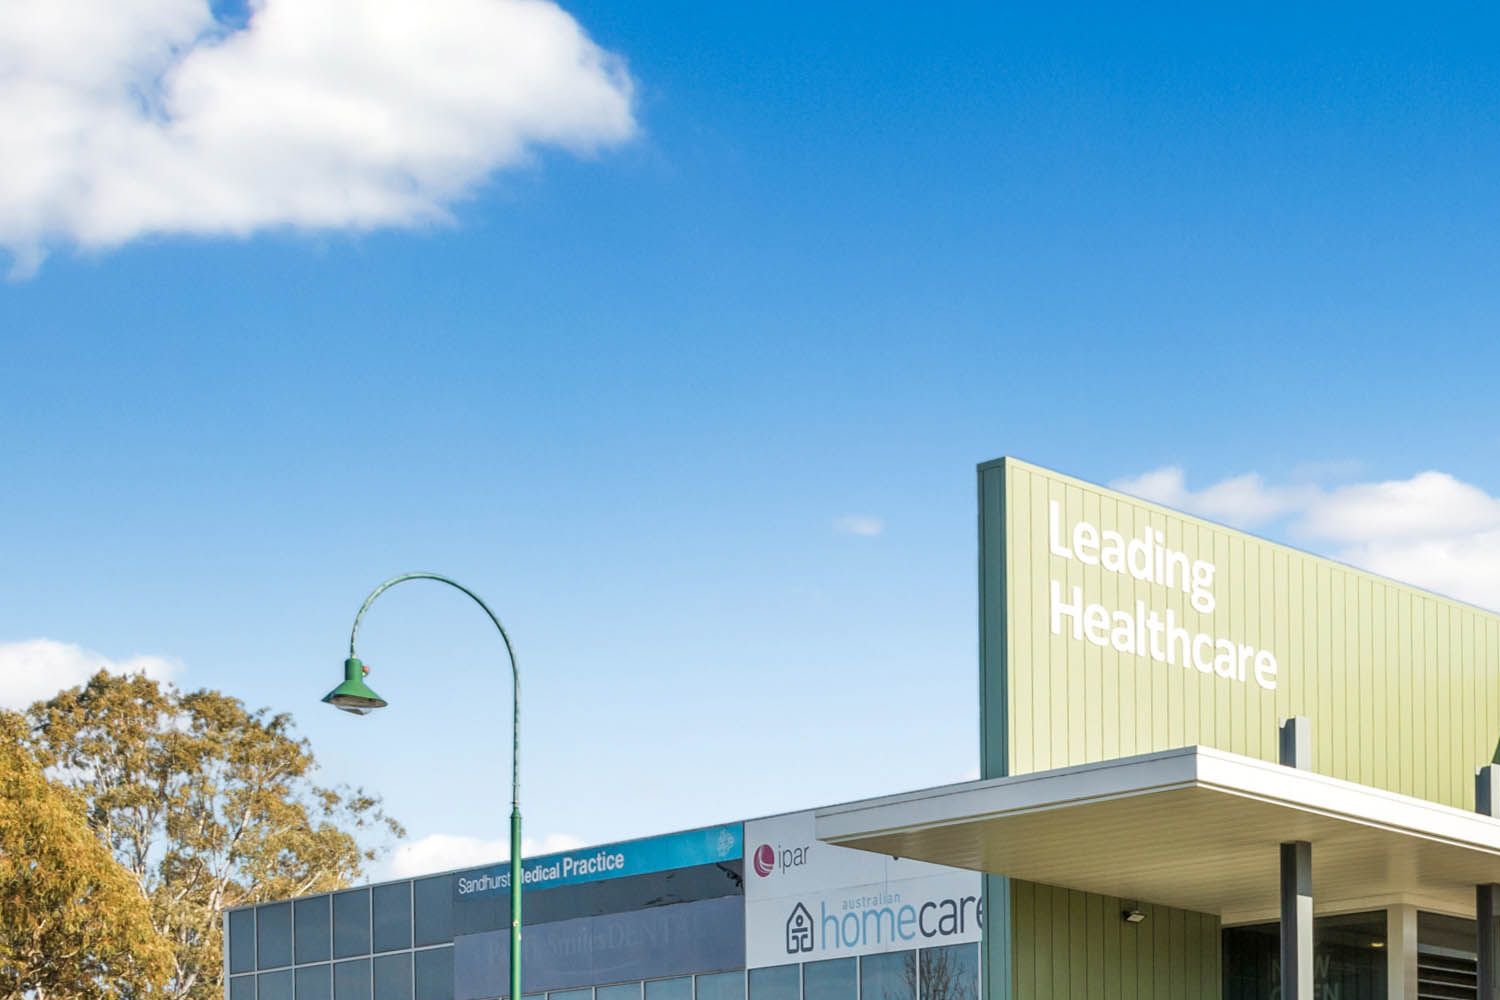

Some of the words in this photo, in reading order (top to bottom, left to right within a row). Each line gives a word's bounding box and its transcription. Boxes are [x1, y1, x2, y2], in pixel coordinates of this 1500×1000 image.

[1050, 500, 1216, 614] Leading
[1050, 580, 1278, 690] Healthcare
[458, 872, 512, 895] Sandhurst
[521, 862, 560, 884] edical
[563, 851, 625, 878] Practice
[777, 844, 809, 874] ipar
[842, 893, 900, 910] australian
